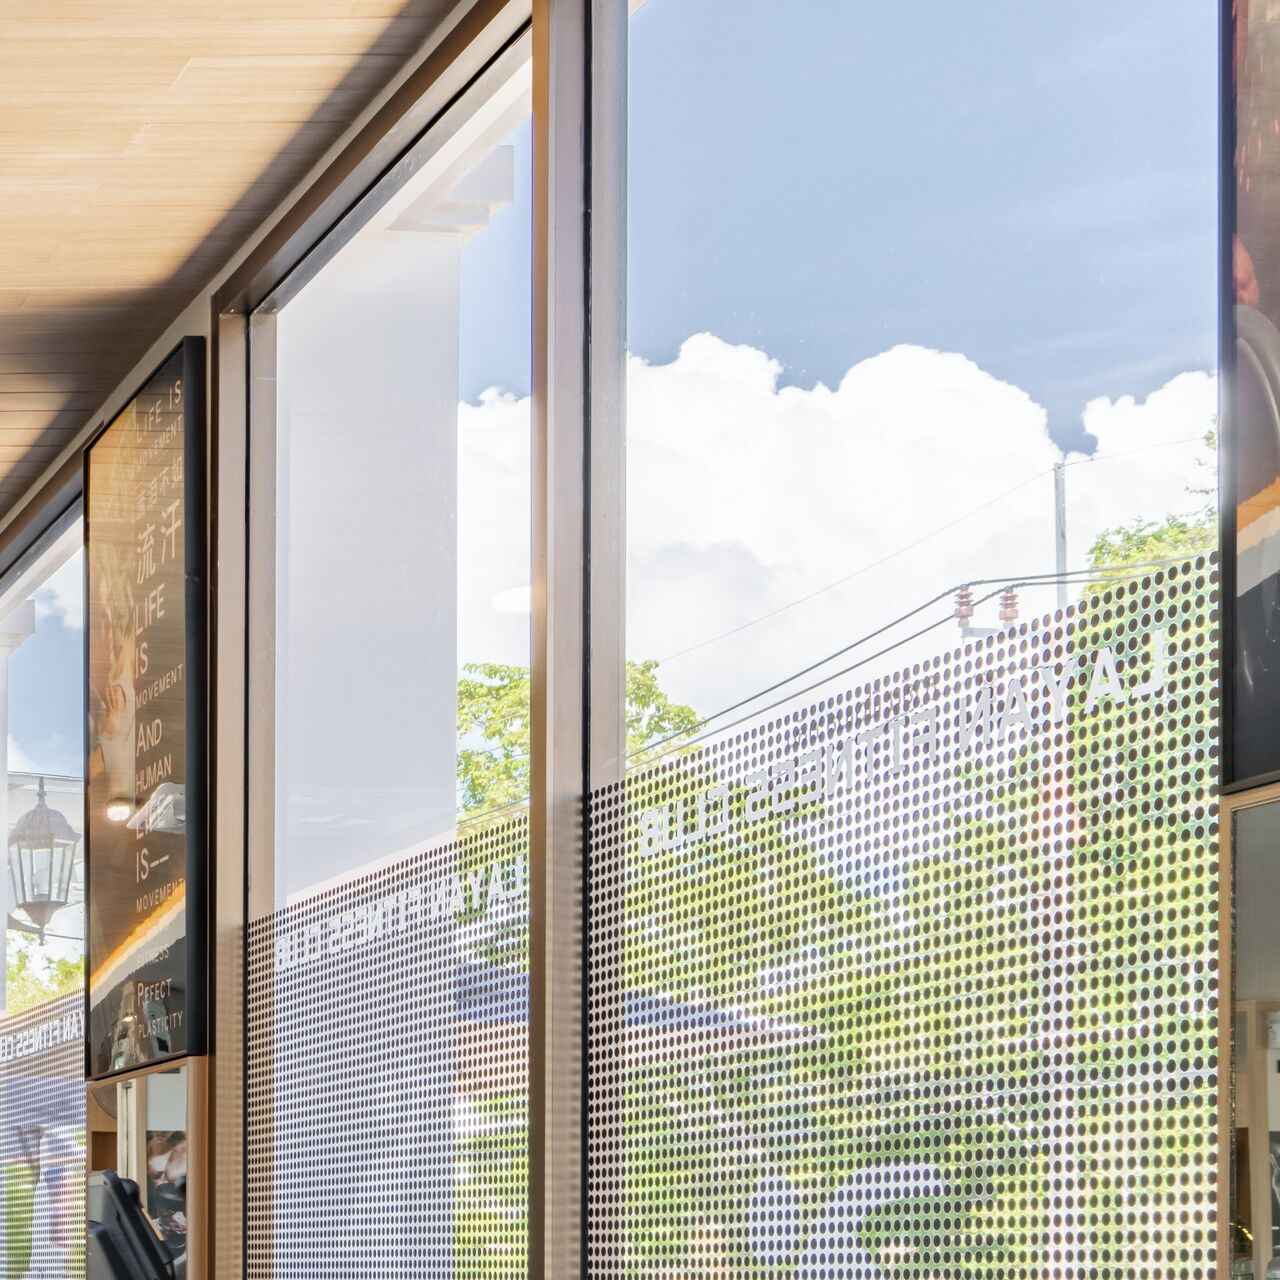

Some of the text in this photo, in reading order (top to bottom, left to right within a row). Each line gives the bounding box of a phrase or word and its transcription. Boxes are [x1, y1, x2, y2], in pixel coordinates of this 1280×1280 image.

[136, 379, 182, 444] LIFE IS
[135, 415, 184, 474] MOVEMENT
[136, 499, 182, 585] 流汗
[135, 583, 166, 637] LIFE
[135, 642, 149, 679] IS
[135, 663, 184, 709] MOVEMENT
[136, 718, 163, 758] AND
[135, 753, 173, 796] HUMAN
[136, 877, 185, 914] MOVEMENT
[137, 978, 173, 1007] PEFECT
[138, 1010, 184, 1041] PLASTICITY
